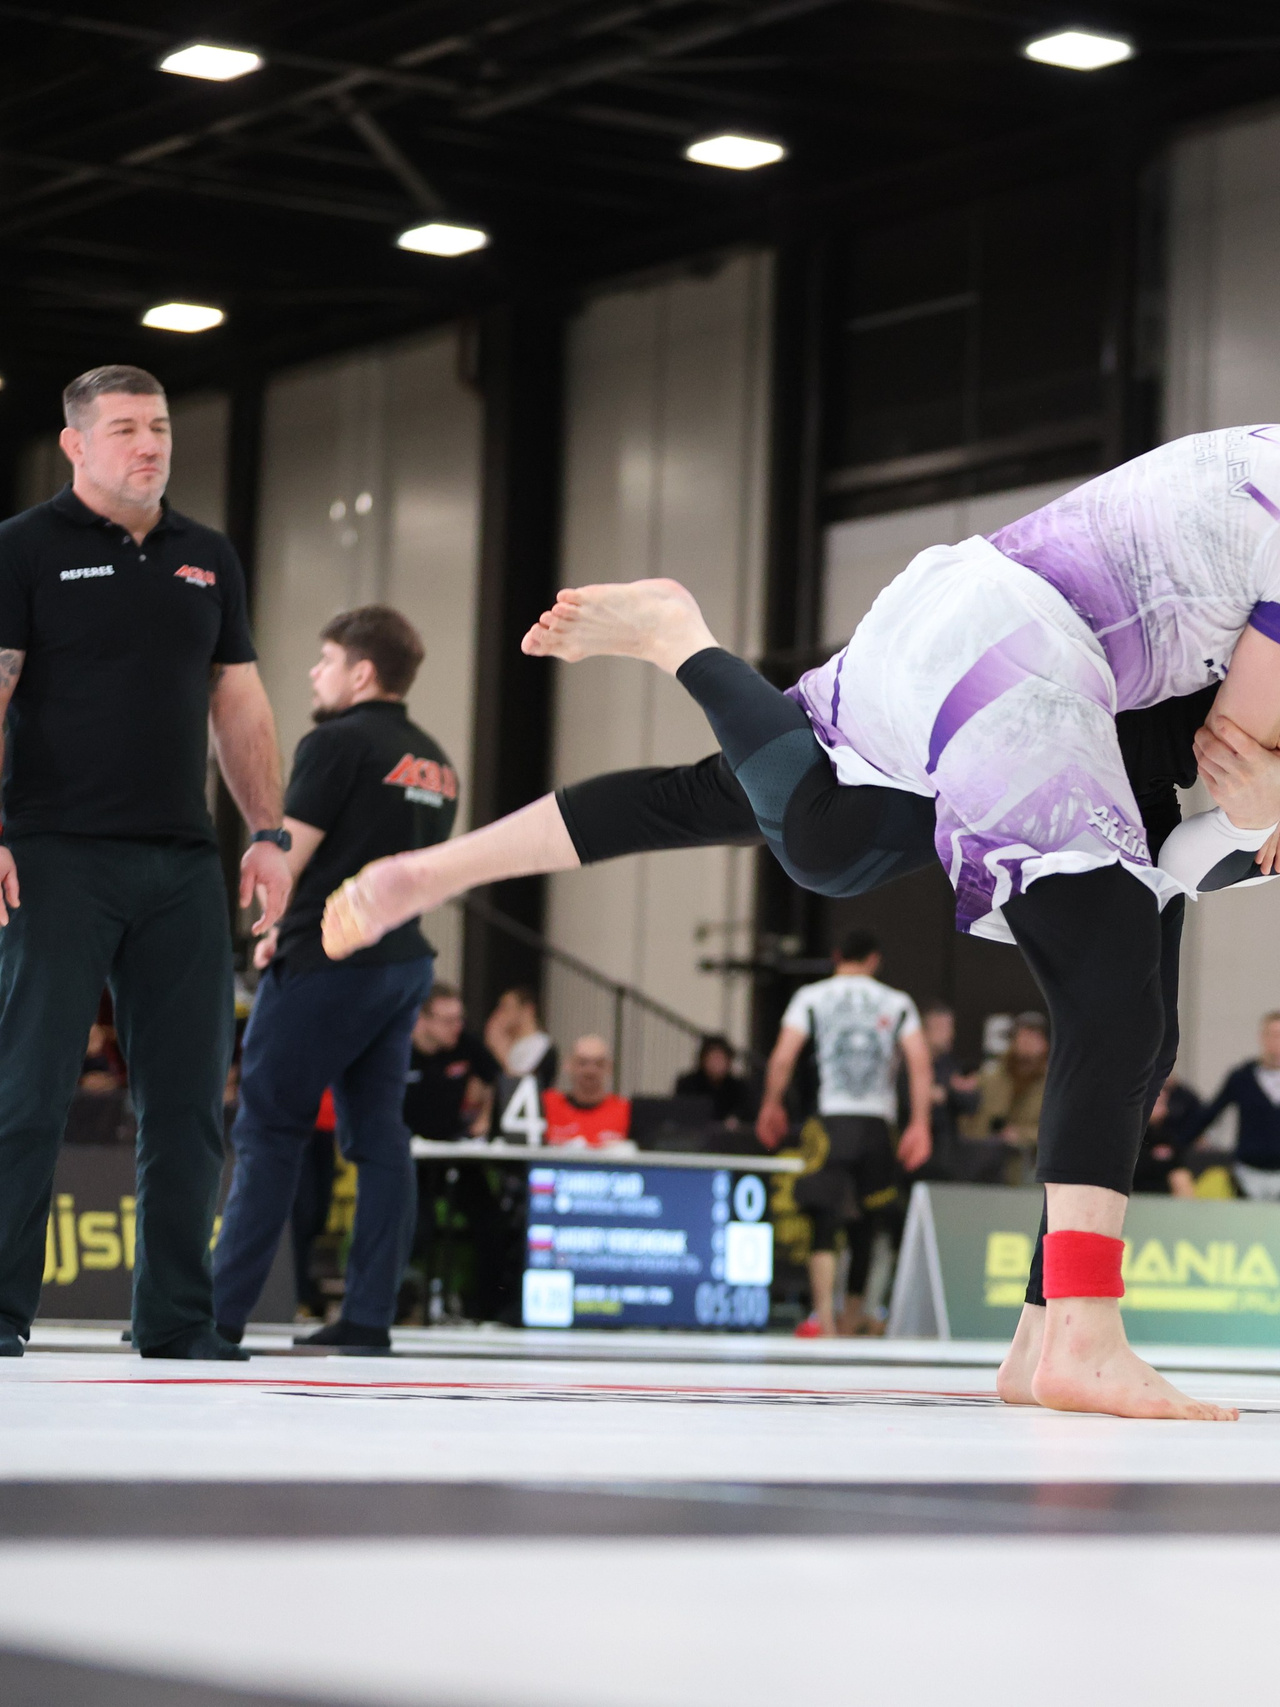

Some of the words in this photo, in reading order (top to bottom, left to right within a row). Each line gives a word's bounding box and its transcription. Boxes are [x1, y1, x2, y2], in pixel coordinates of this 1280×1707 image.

[60, 564, 115, 582] REFEREE
[502, 1074, 548, 1148] 4
[734, 1174, 766, 1222] 0
